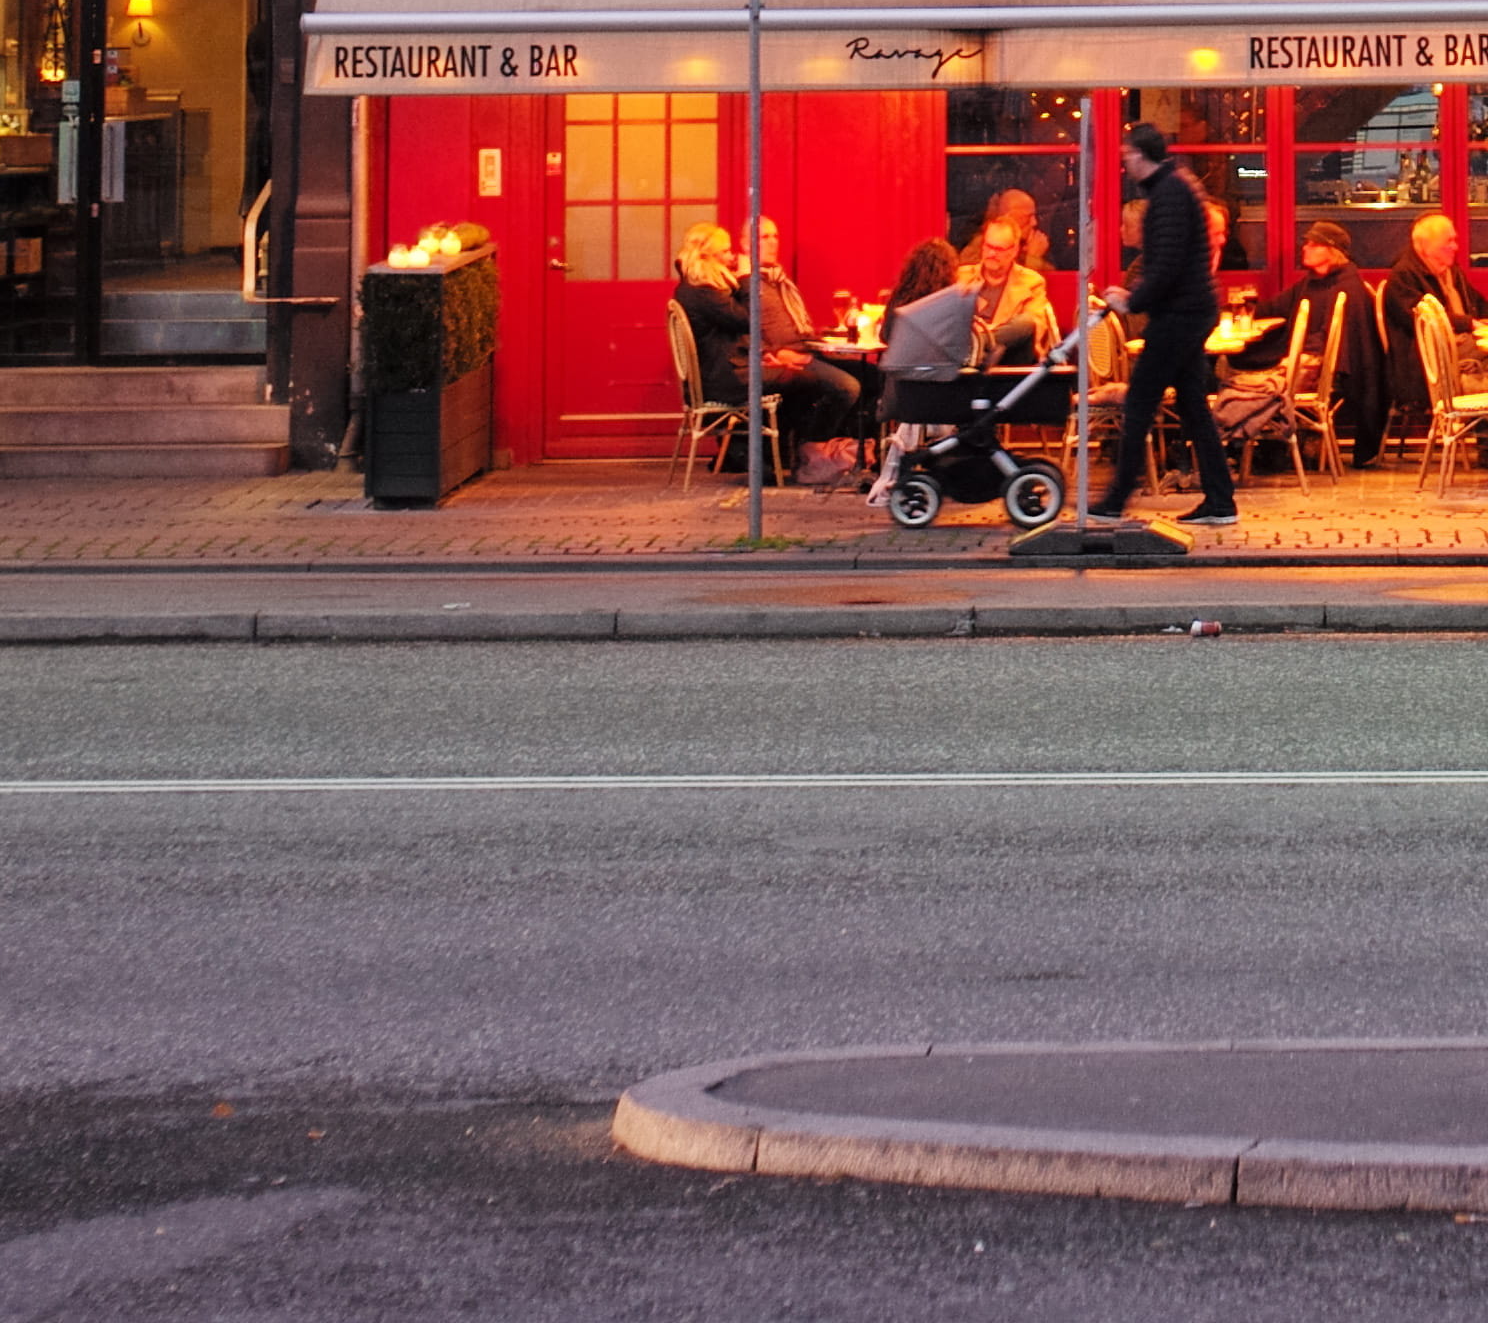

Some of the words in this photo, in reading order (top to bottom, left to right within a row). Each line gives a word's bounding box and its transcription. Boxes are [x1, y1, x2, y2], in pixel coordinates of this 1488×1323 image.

[334, 45, 492, 79] RESTAURANT
[499, 46, 519, 77] &
[529, 44, 578, 77] BAR
[845, 36, 984, 79] Ravage
[1249, 34, 1407, 70] RESTAURANT
[1414, 36, 1434, 67] &
